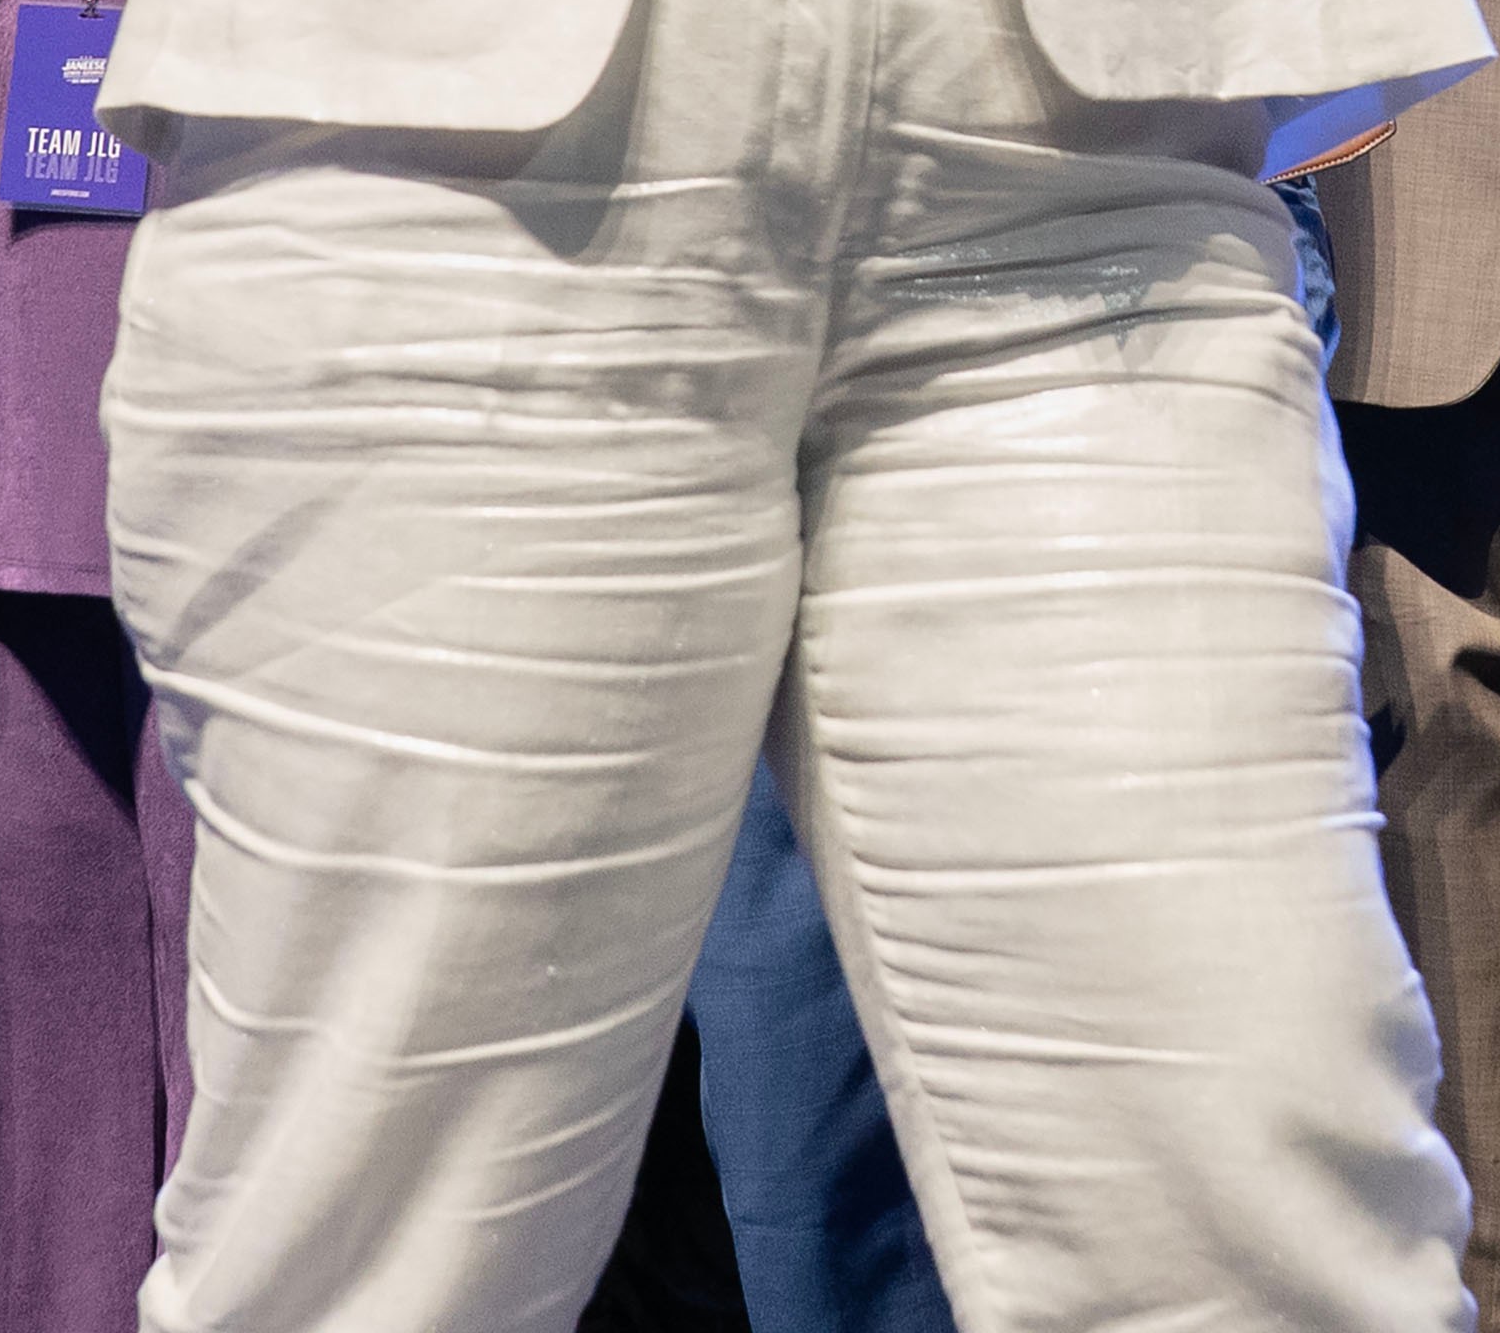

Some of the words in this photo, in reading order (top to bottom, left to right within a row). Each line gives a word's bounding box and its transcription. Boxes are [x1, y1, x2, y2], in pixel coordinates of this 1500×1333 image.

[28, 127, 82, 156] TEAM
[86, 131, 121, 159] JLG
[25, 153, 79, 181] TEAM
[83, 156, 119, 184] JLG
